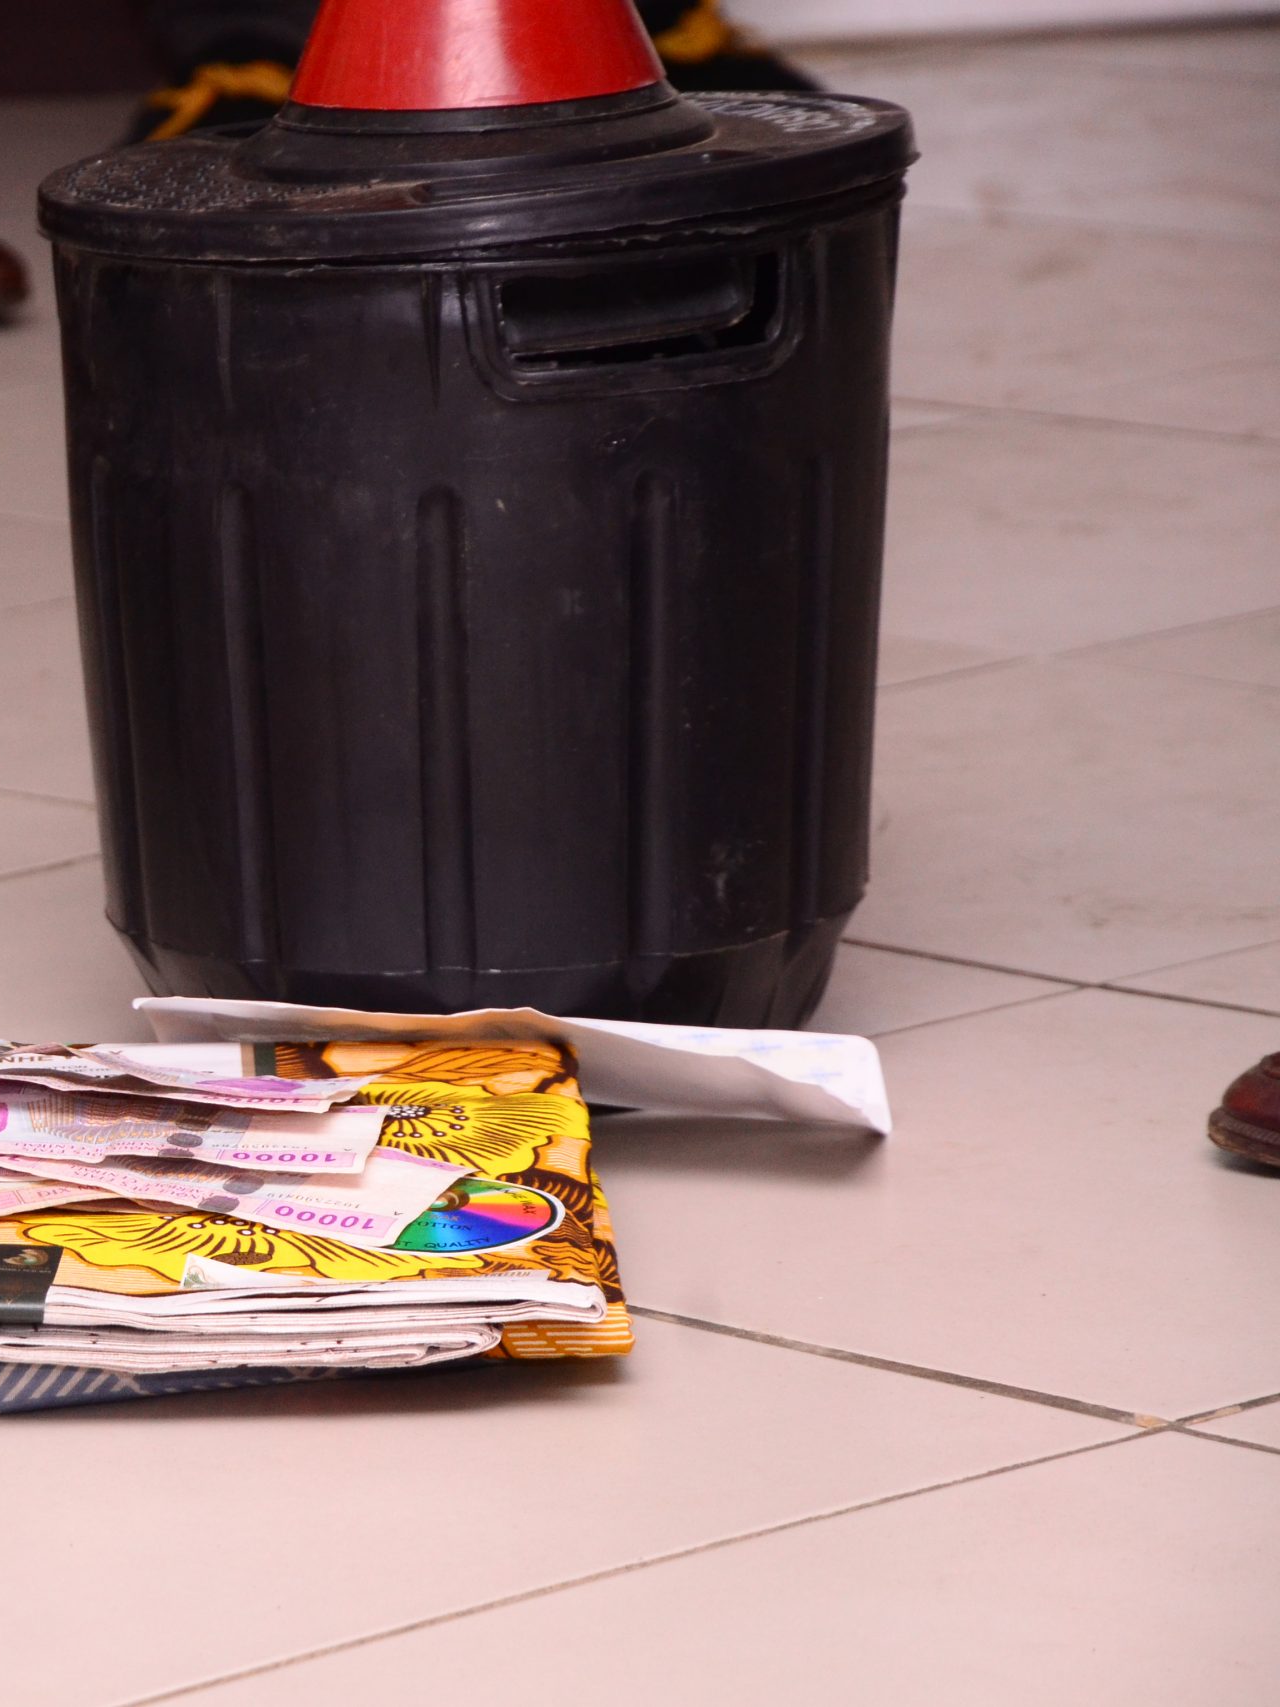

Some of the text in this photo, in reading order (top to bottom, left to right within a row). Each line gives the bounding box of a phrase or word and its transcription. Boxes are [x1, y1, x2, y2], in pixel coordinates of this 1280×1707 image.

[232, 1152, 337, 1163] 10000
[274, 1205, 376, 1231] 10000
[417, 1221, 473, 1231] OTTON
[423, 1237, 491, 1249] QUALITY
